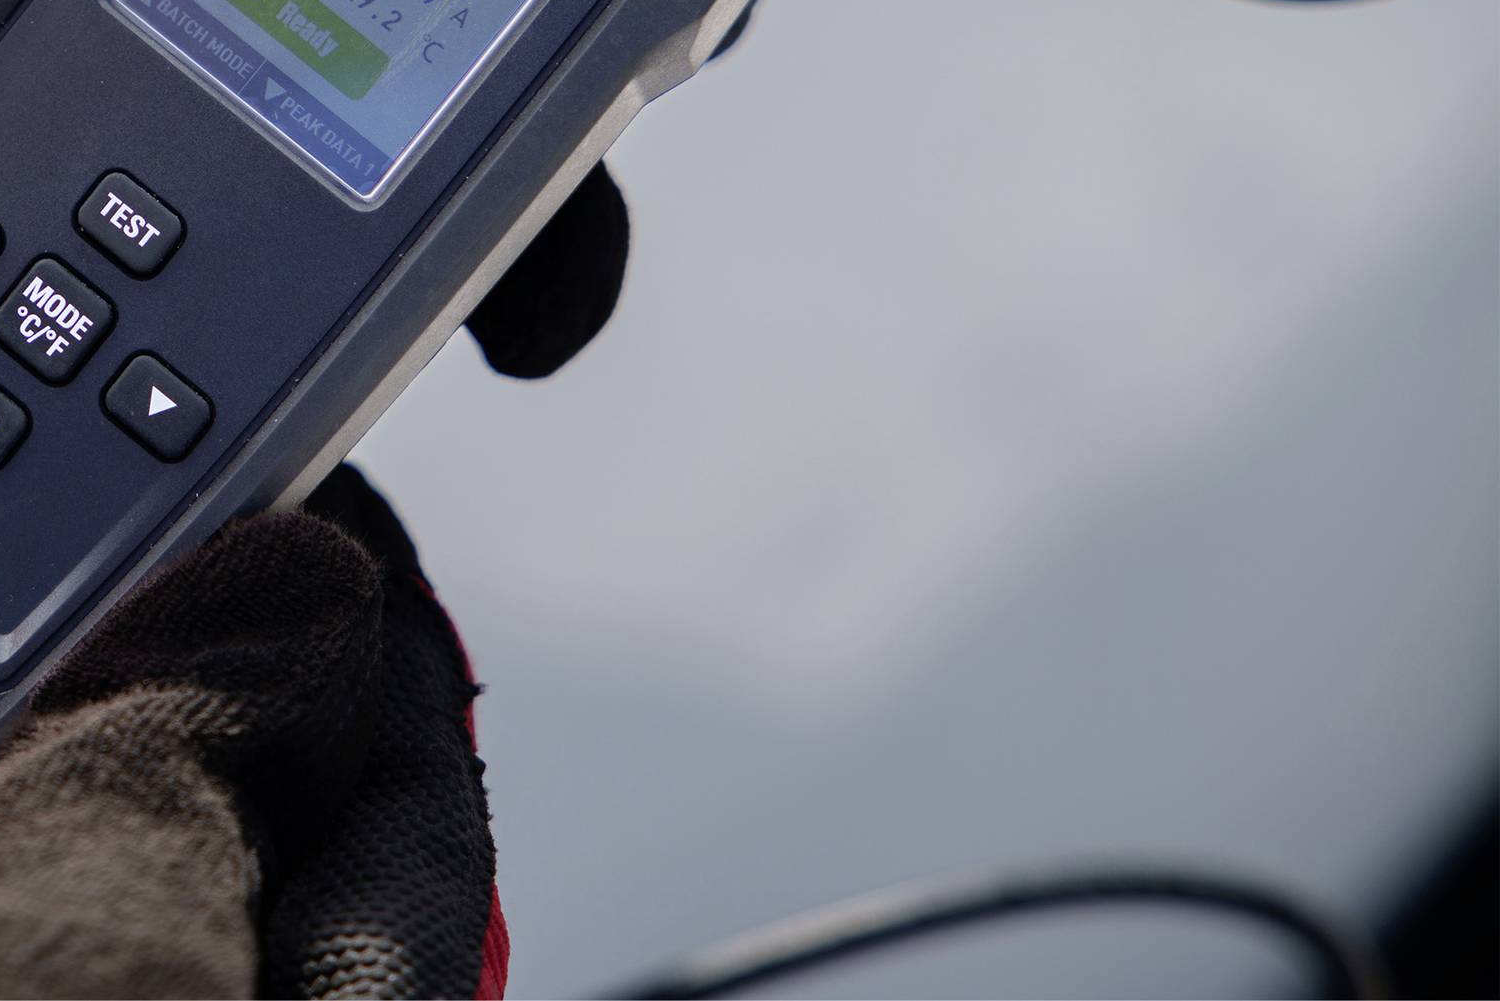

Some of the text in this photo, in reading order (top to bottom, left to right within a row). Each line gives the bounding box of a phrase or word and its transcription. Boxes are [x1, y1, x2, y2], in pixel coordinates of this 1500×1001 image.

[275, 1, 339, 57] Ready
[450, 8, 469, 28] A
[205, 37, 254, 79] MODE
[423, 33, 445, 63] °C
[280, 96, 324, 136] PEAK
[321, 129, 361, 169] DATA
[99, 192, 160, 248] TEST
[17, 306, 70, 357] °C/°F
[22, 276, 93, 340] MODE
